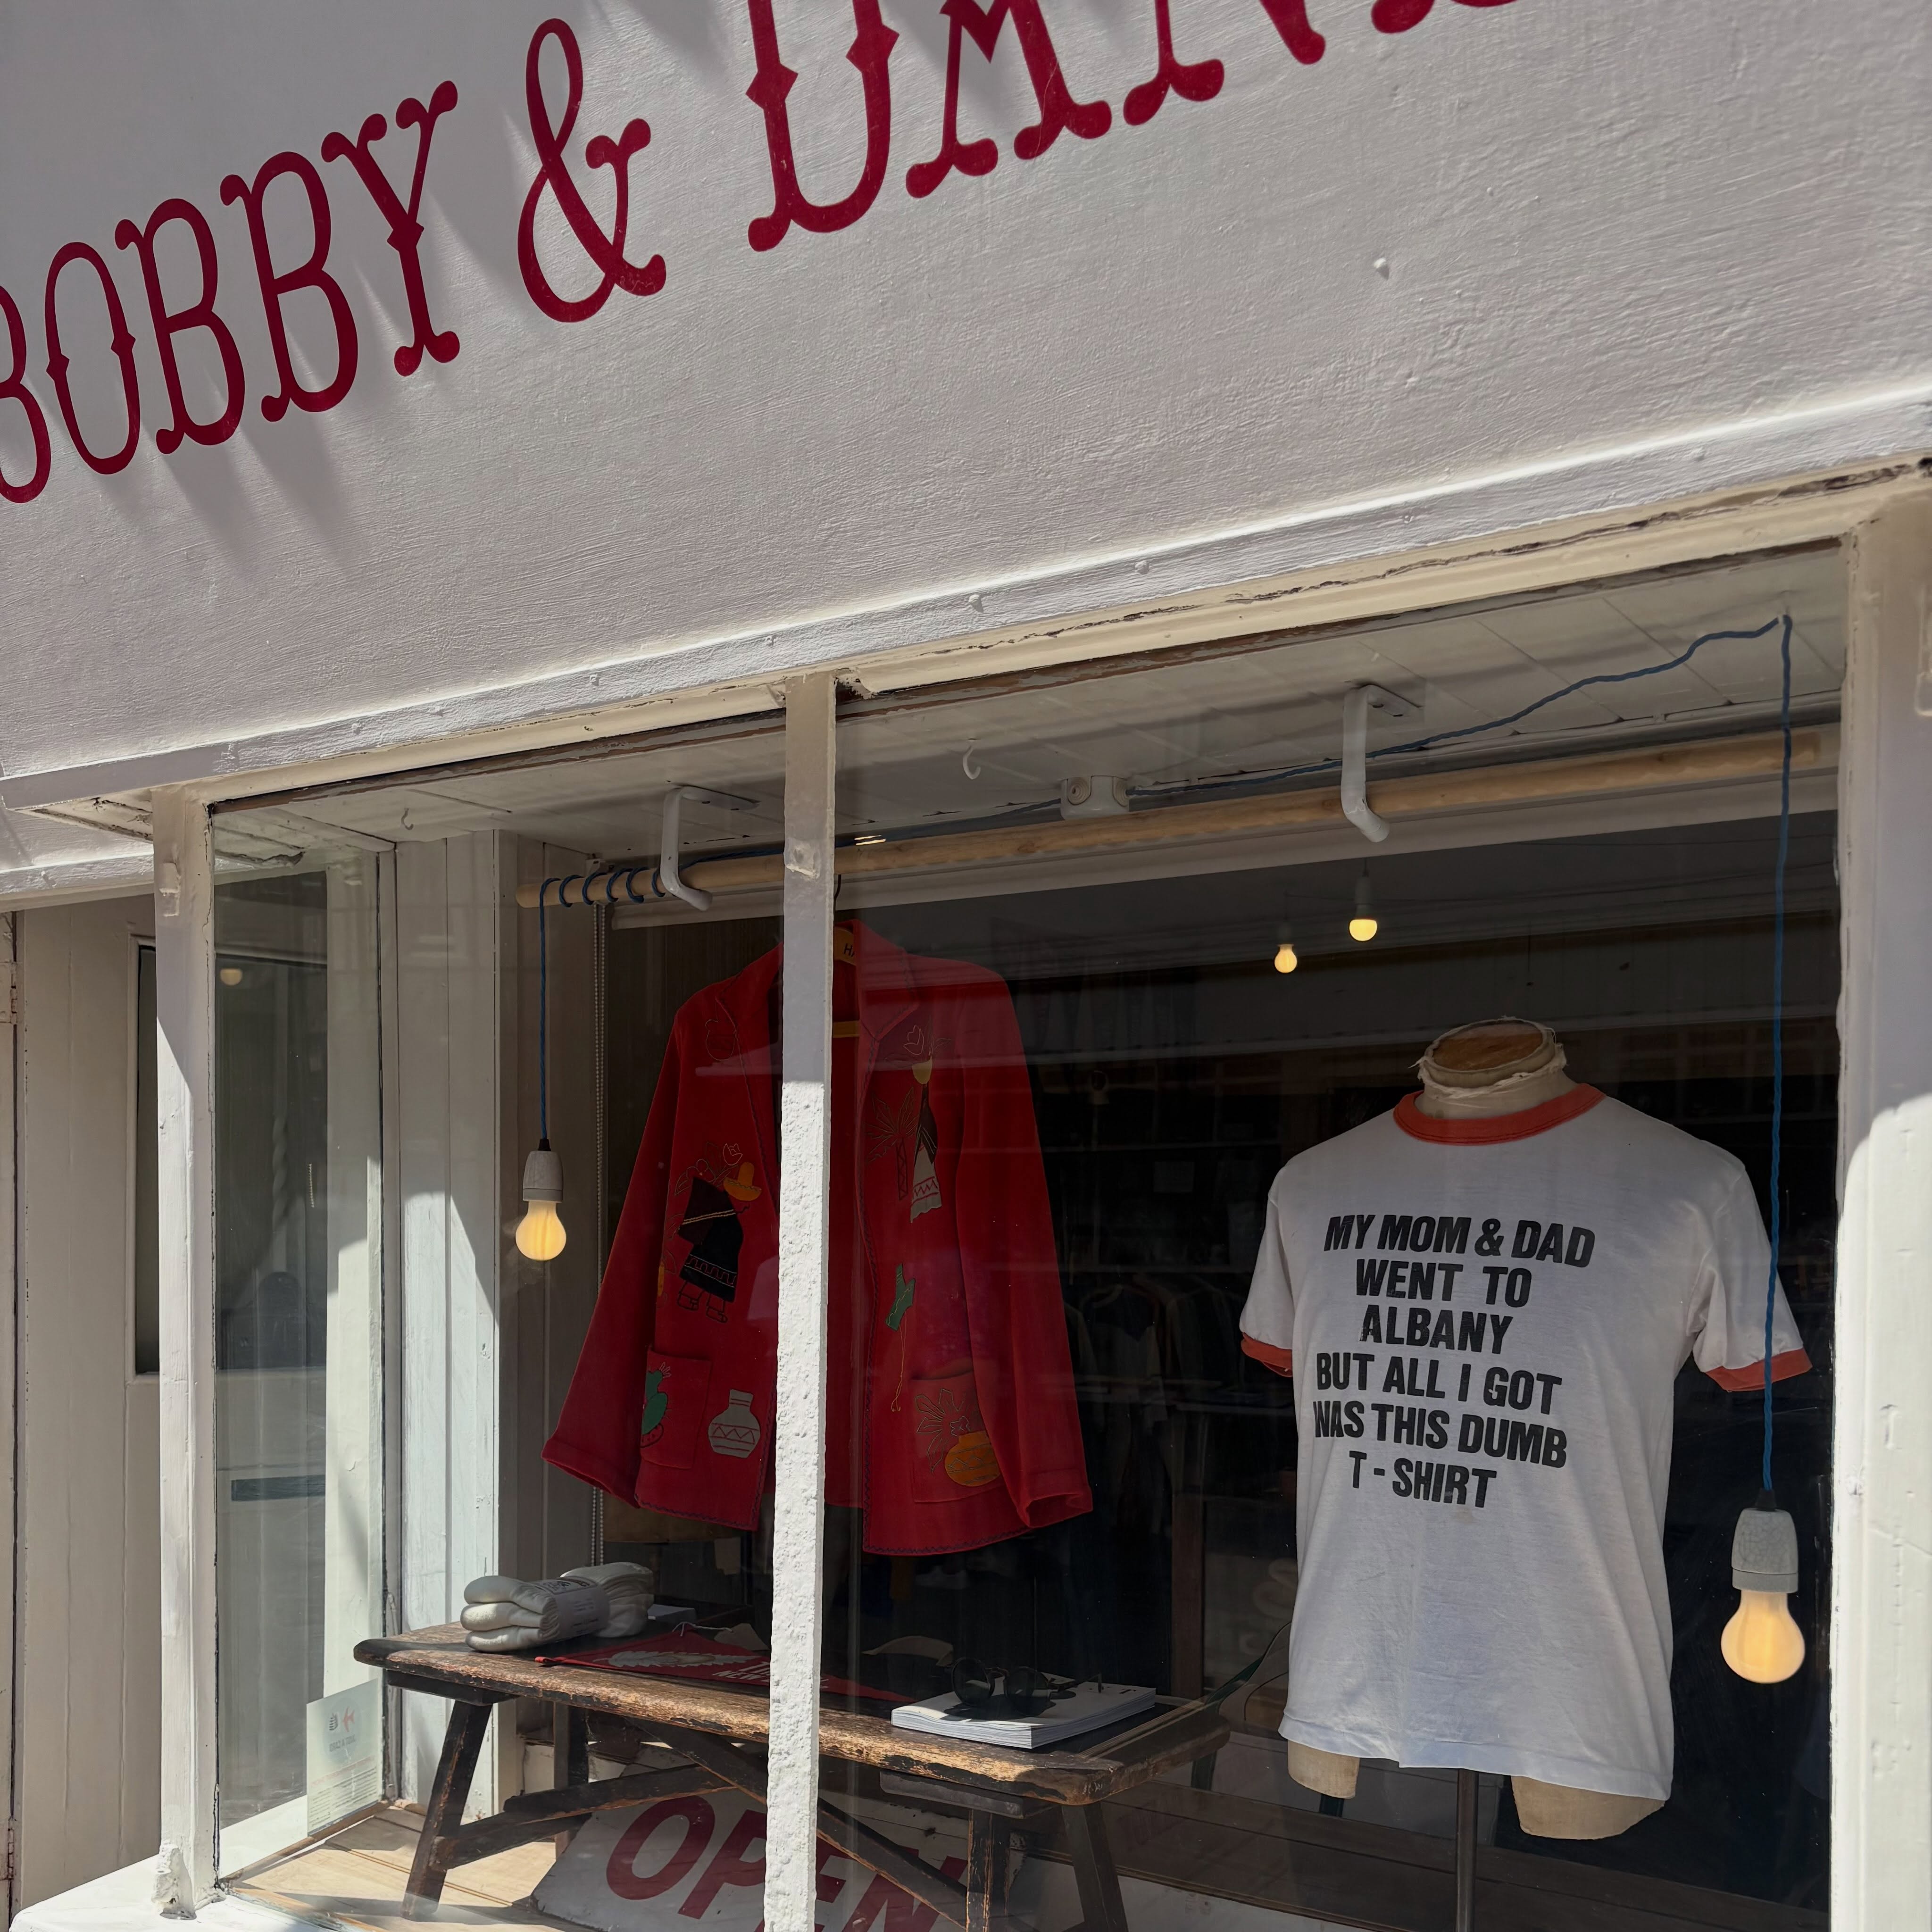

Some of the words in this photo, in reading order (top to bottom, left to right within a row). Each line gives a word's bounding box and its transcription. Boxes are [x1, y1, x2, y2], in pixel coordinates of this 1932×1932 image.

[517, 19, 666, 323] &
[1324, 1215, 1376, 1251] MY
[1377, 1214, 1472, 1254] MOM
[1474, 1218, 1505, 1257] &
[1511, 1220, 1596, 1268] DAD
[1356, 1258, 1464, 1301] WENT
[1482, 1266, 1532, 1308] TO
[1359, 1304, 1514, 1355] ALBANY
[1316, 1352, 1375, 1391] BUT
[1382, 1356, 1445, 1399] ALL
[1458, 1364, 1472, 1402] I
[1483, 1366, 1563, 1416] GOT
[1313, 1400, 1365, 1438] WAS
[1371, 1403, 1450, 1449] THIS
[1457, 1414, 1567, 1468] DUMB
